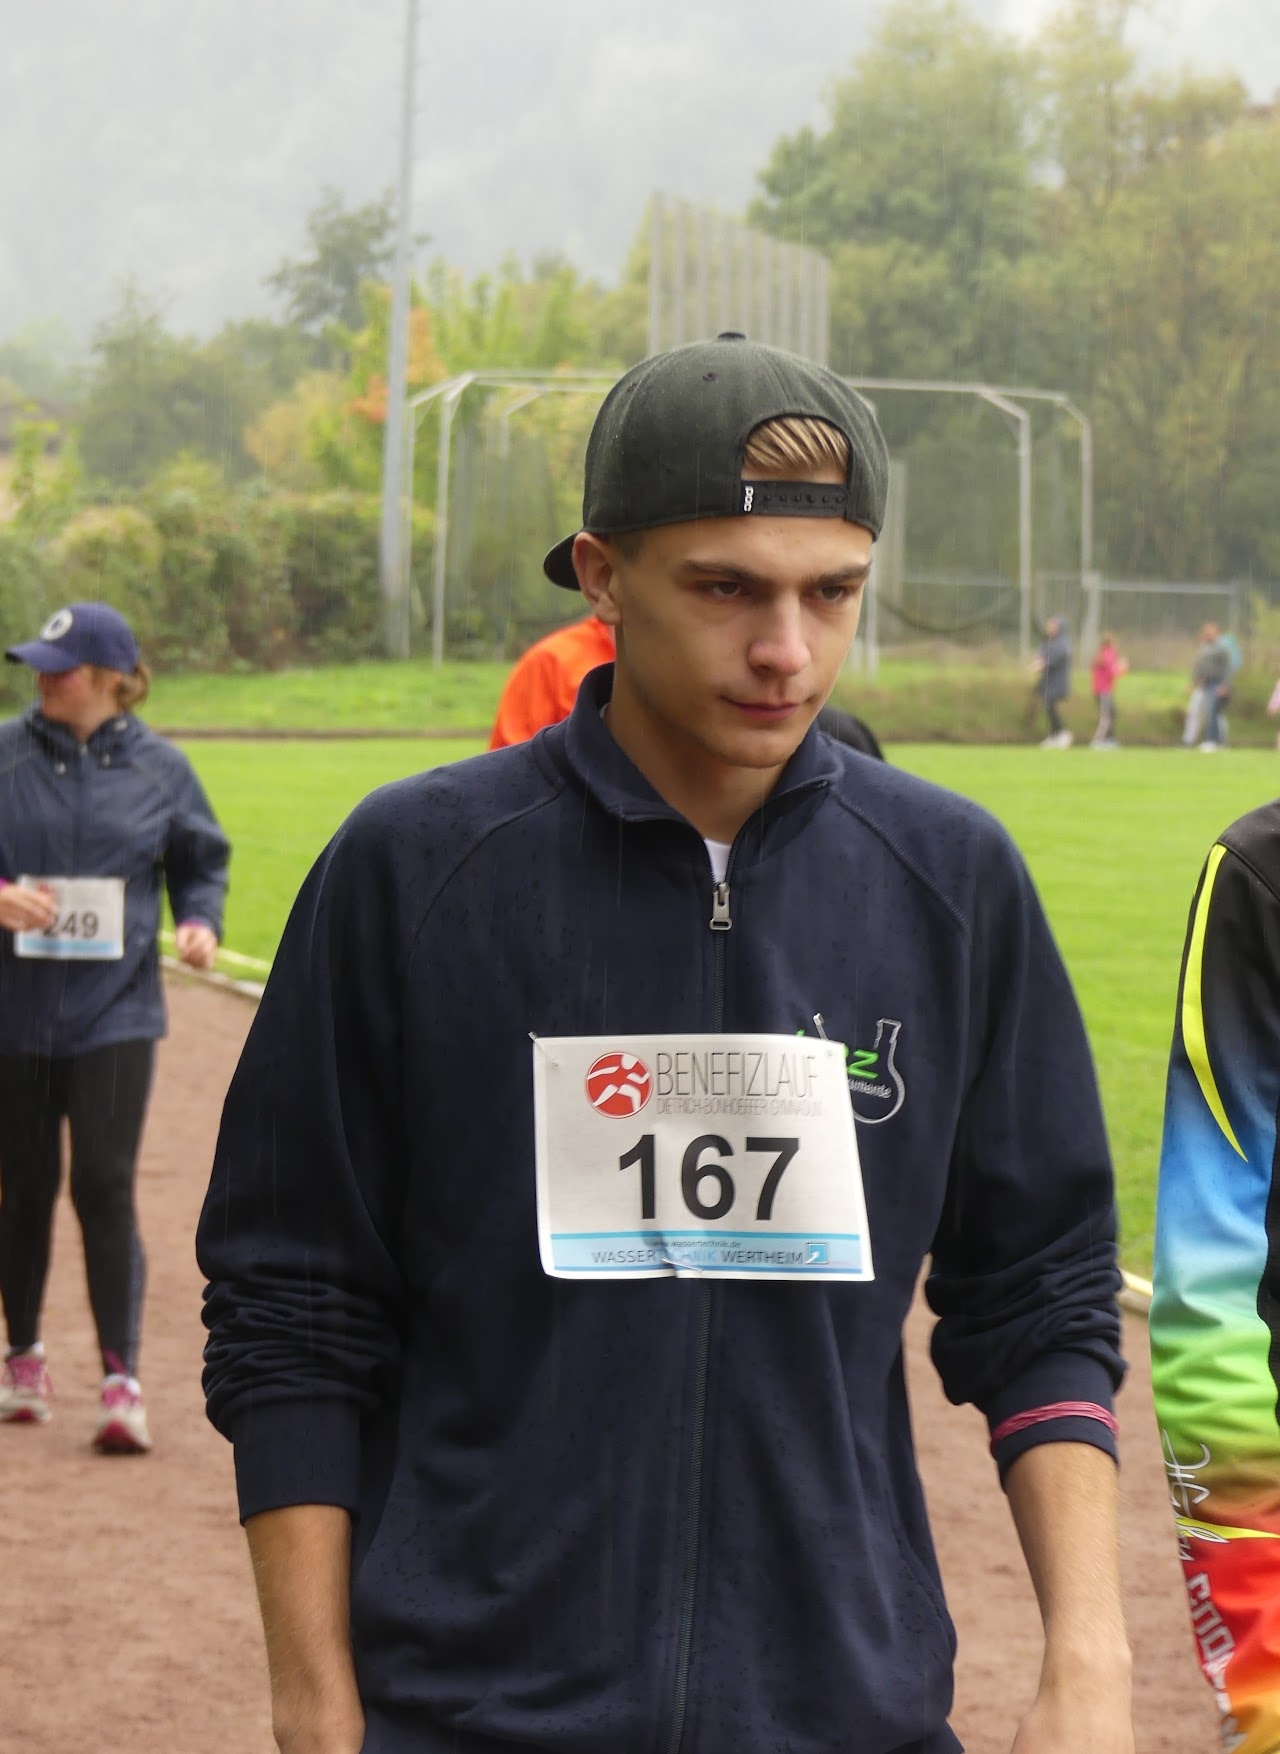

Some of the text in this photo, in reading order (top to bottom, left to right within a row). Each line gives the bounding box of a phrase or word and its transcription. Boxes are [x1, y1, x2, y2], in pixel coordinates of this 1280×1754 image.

[656, 1051, 818, 1098] BENEFIZLAUF
[619, 1134, 801, 1222] 167
[721, 1249, 804, 1265] WERTHEIM
